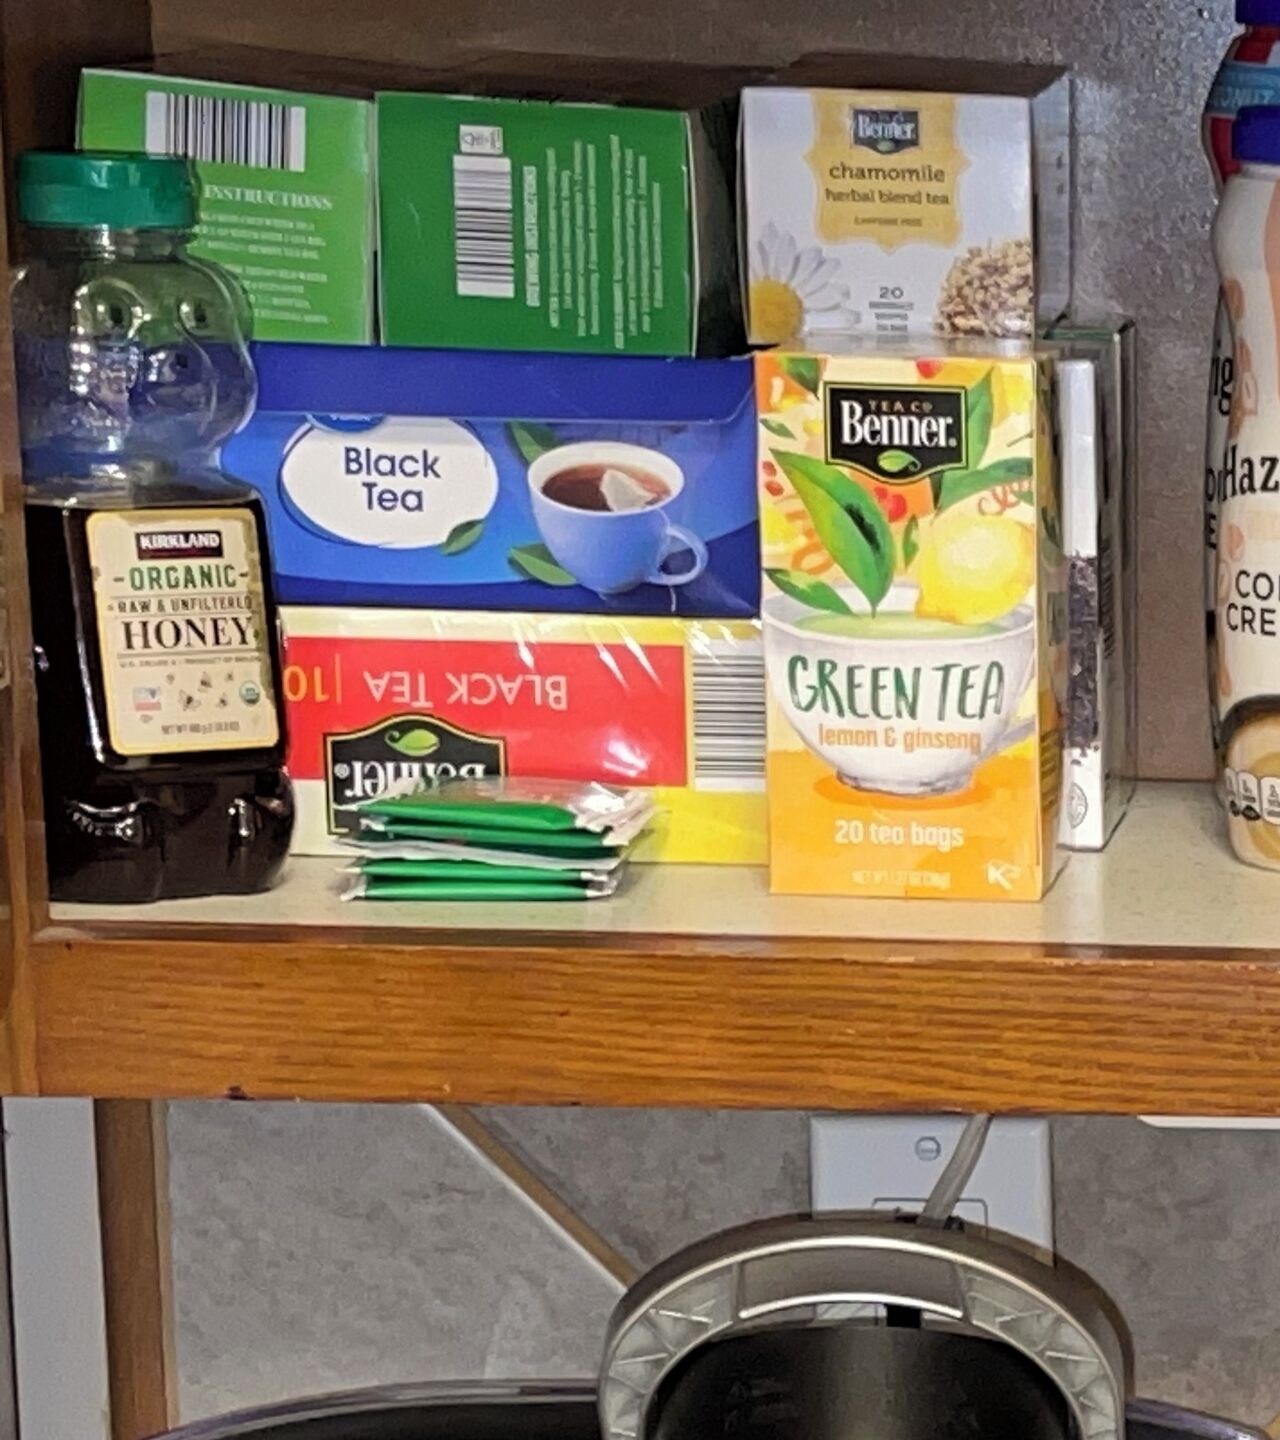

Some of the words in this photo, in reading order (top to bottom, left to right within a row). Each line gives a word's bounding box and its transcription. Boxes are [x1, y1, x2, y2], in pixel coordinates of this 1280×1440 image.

[828, 160, 946, 183] chamomile
[203, 184, 333, 210] INSTRUCTIONS
[825, 187, 875, 204] herbal
[878, 189, 922, 205] blend
[879, 286, 905, 299] 20
[867, 400, 905, 414] TEA
[840, 399, 954, 448] Benner
[343, 445, 442, 479] Black
[361, 481, 425, 513] Tea
[139, 532, 221, 551] KIRKLAND
[127, 563, 238, 592] ORGANIC
[117, 600, 153, 614] RAW
[120, 615, 253, 652] HONEY
[361, 670, 435, 709] TEA
[446, 671, 569, 711] BLACK
[787, 654, 922, 721] GREEN
[932, 660, 1006, 722] TEA
[818, 723, 878, 748] lemon
[884, 727, 898, 748] &
[903, 730, 983, 754] ginseng
[834, 818, 864, 845] 20
[869, 822, 906, 847] tea
[910, 821, 966, 854] bags
